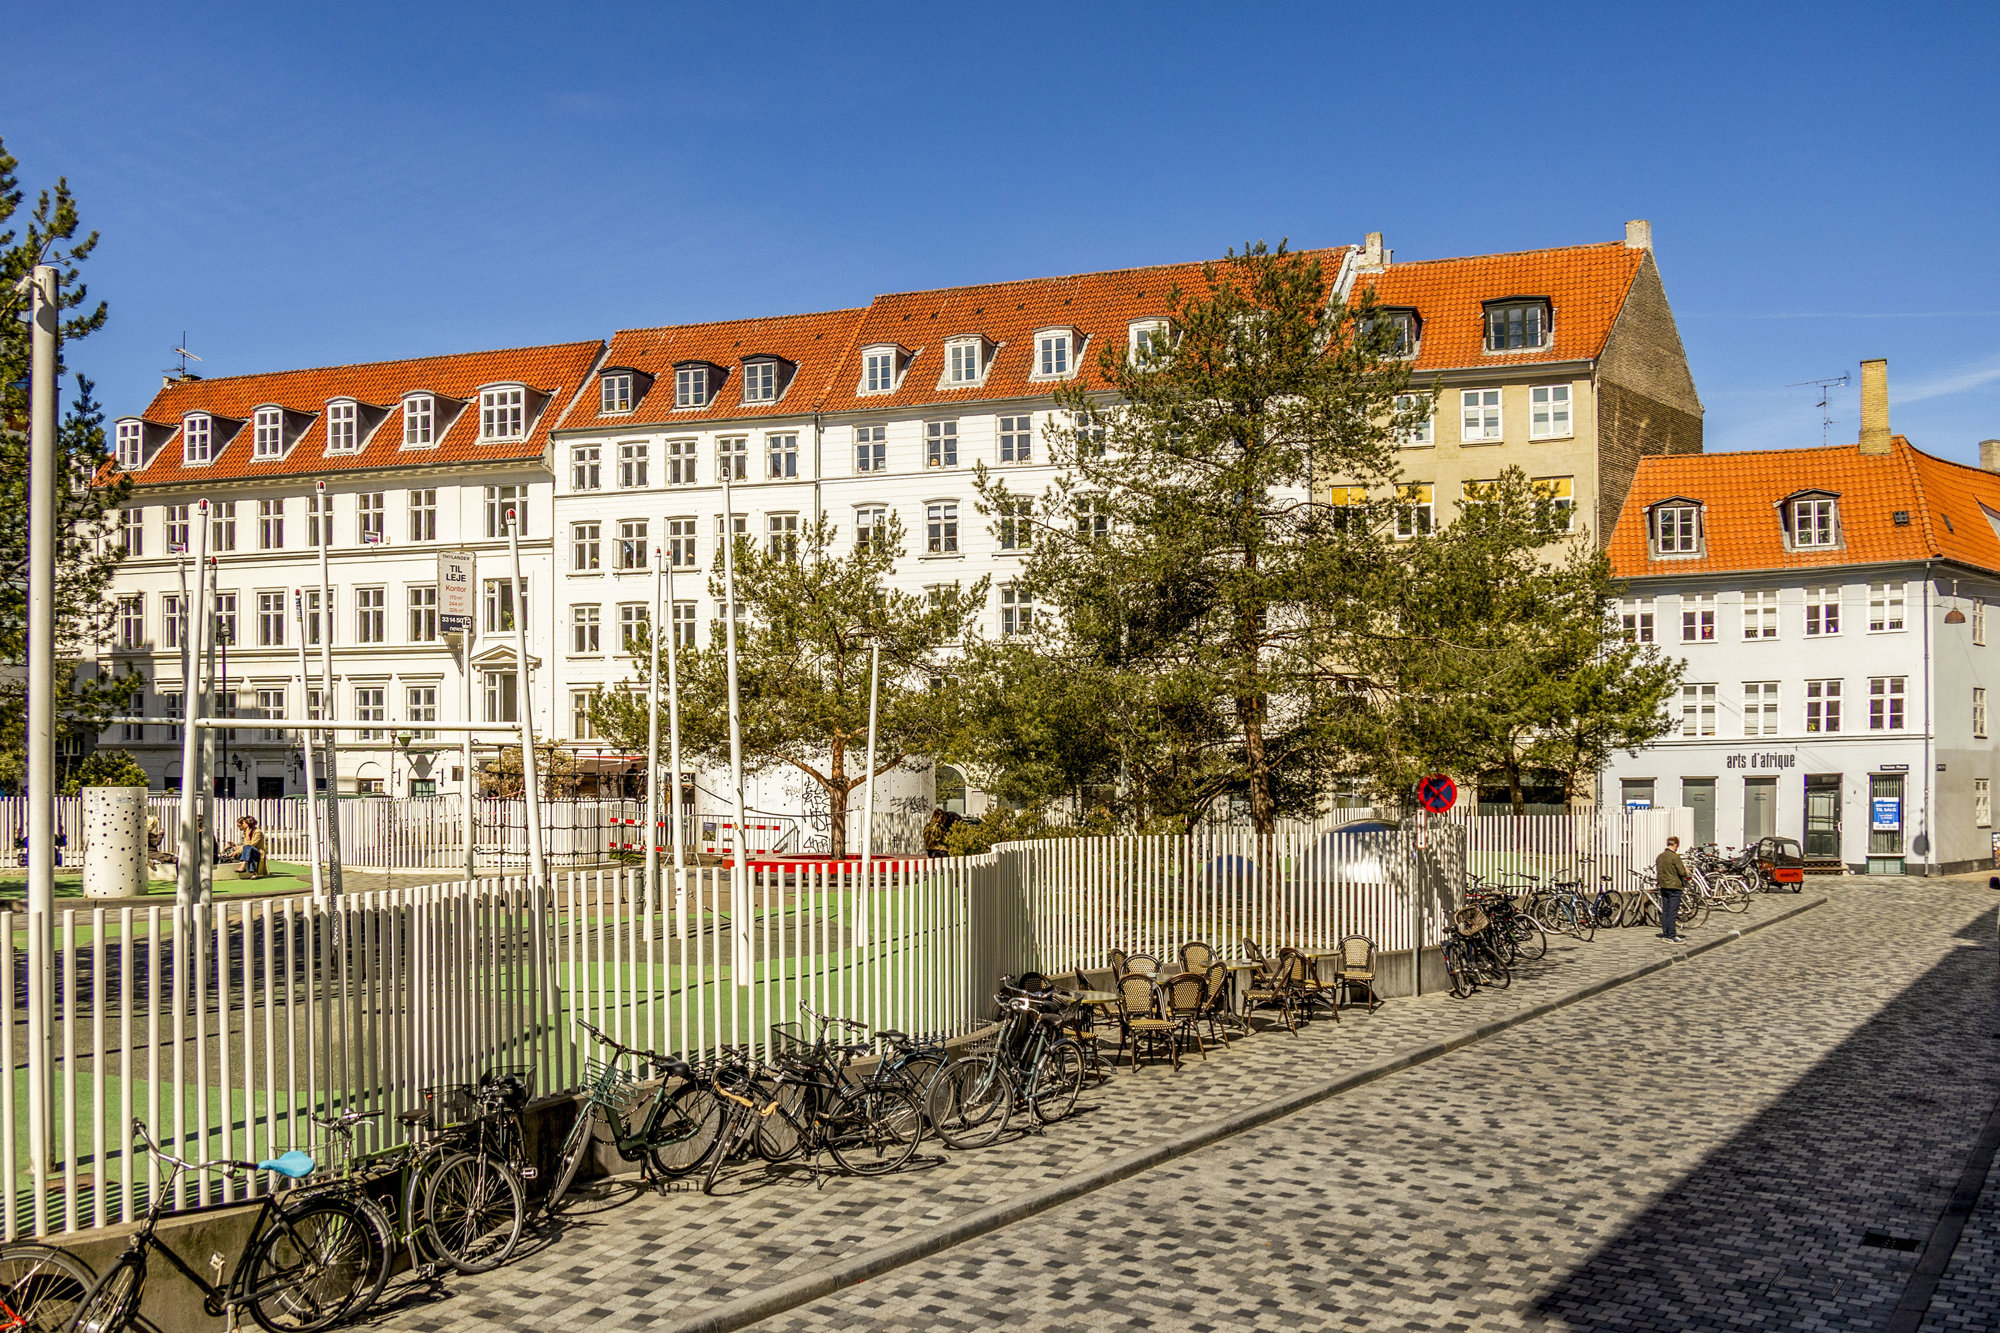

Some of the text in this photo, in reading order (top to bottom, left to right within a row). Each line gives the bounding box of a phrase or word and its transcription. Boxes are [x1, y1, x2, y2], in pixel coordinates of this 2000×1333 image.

[450, 565, 462, 573] TIL
[446, 573, 466, 582] LEJE
[445, 585, 467, 593] Kontor
[1726, 752, 1795, 770] arts d'afrique
